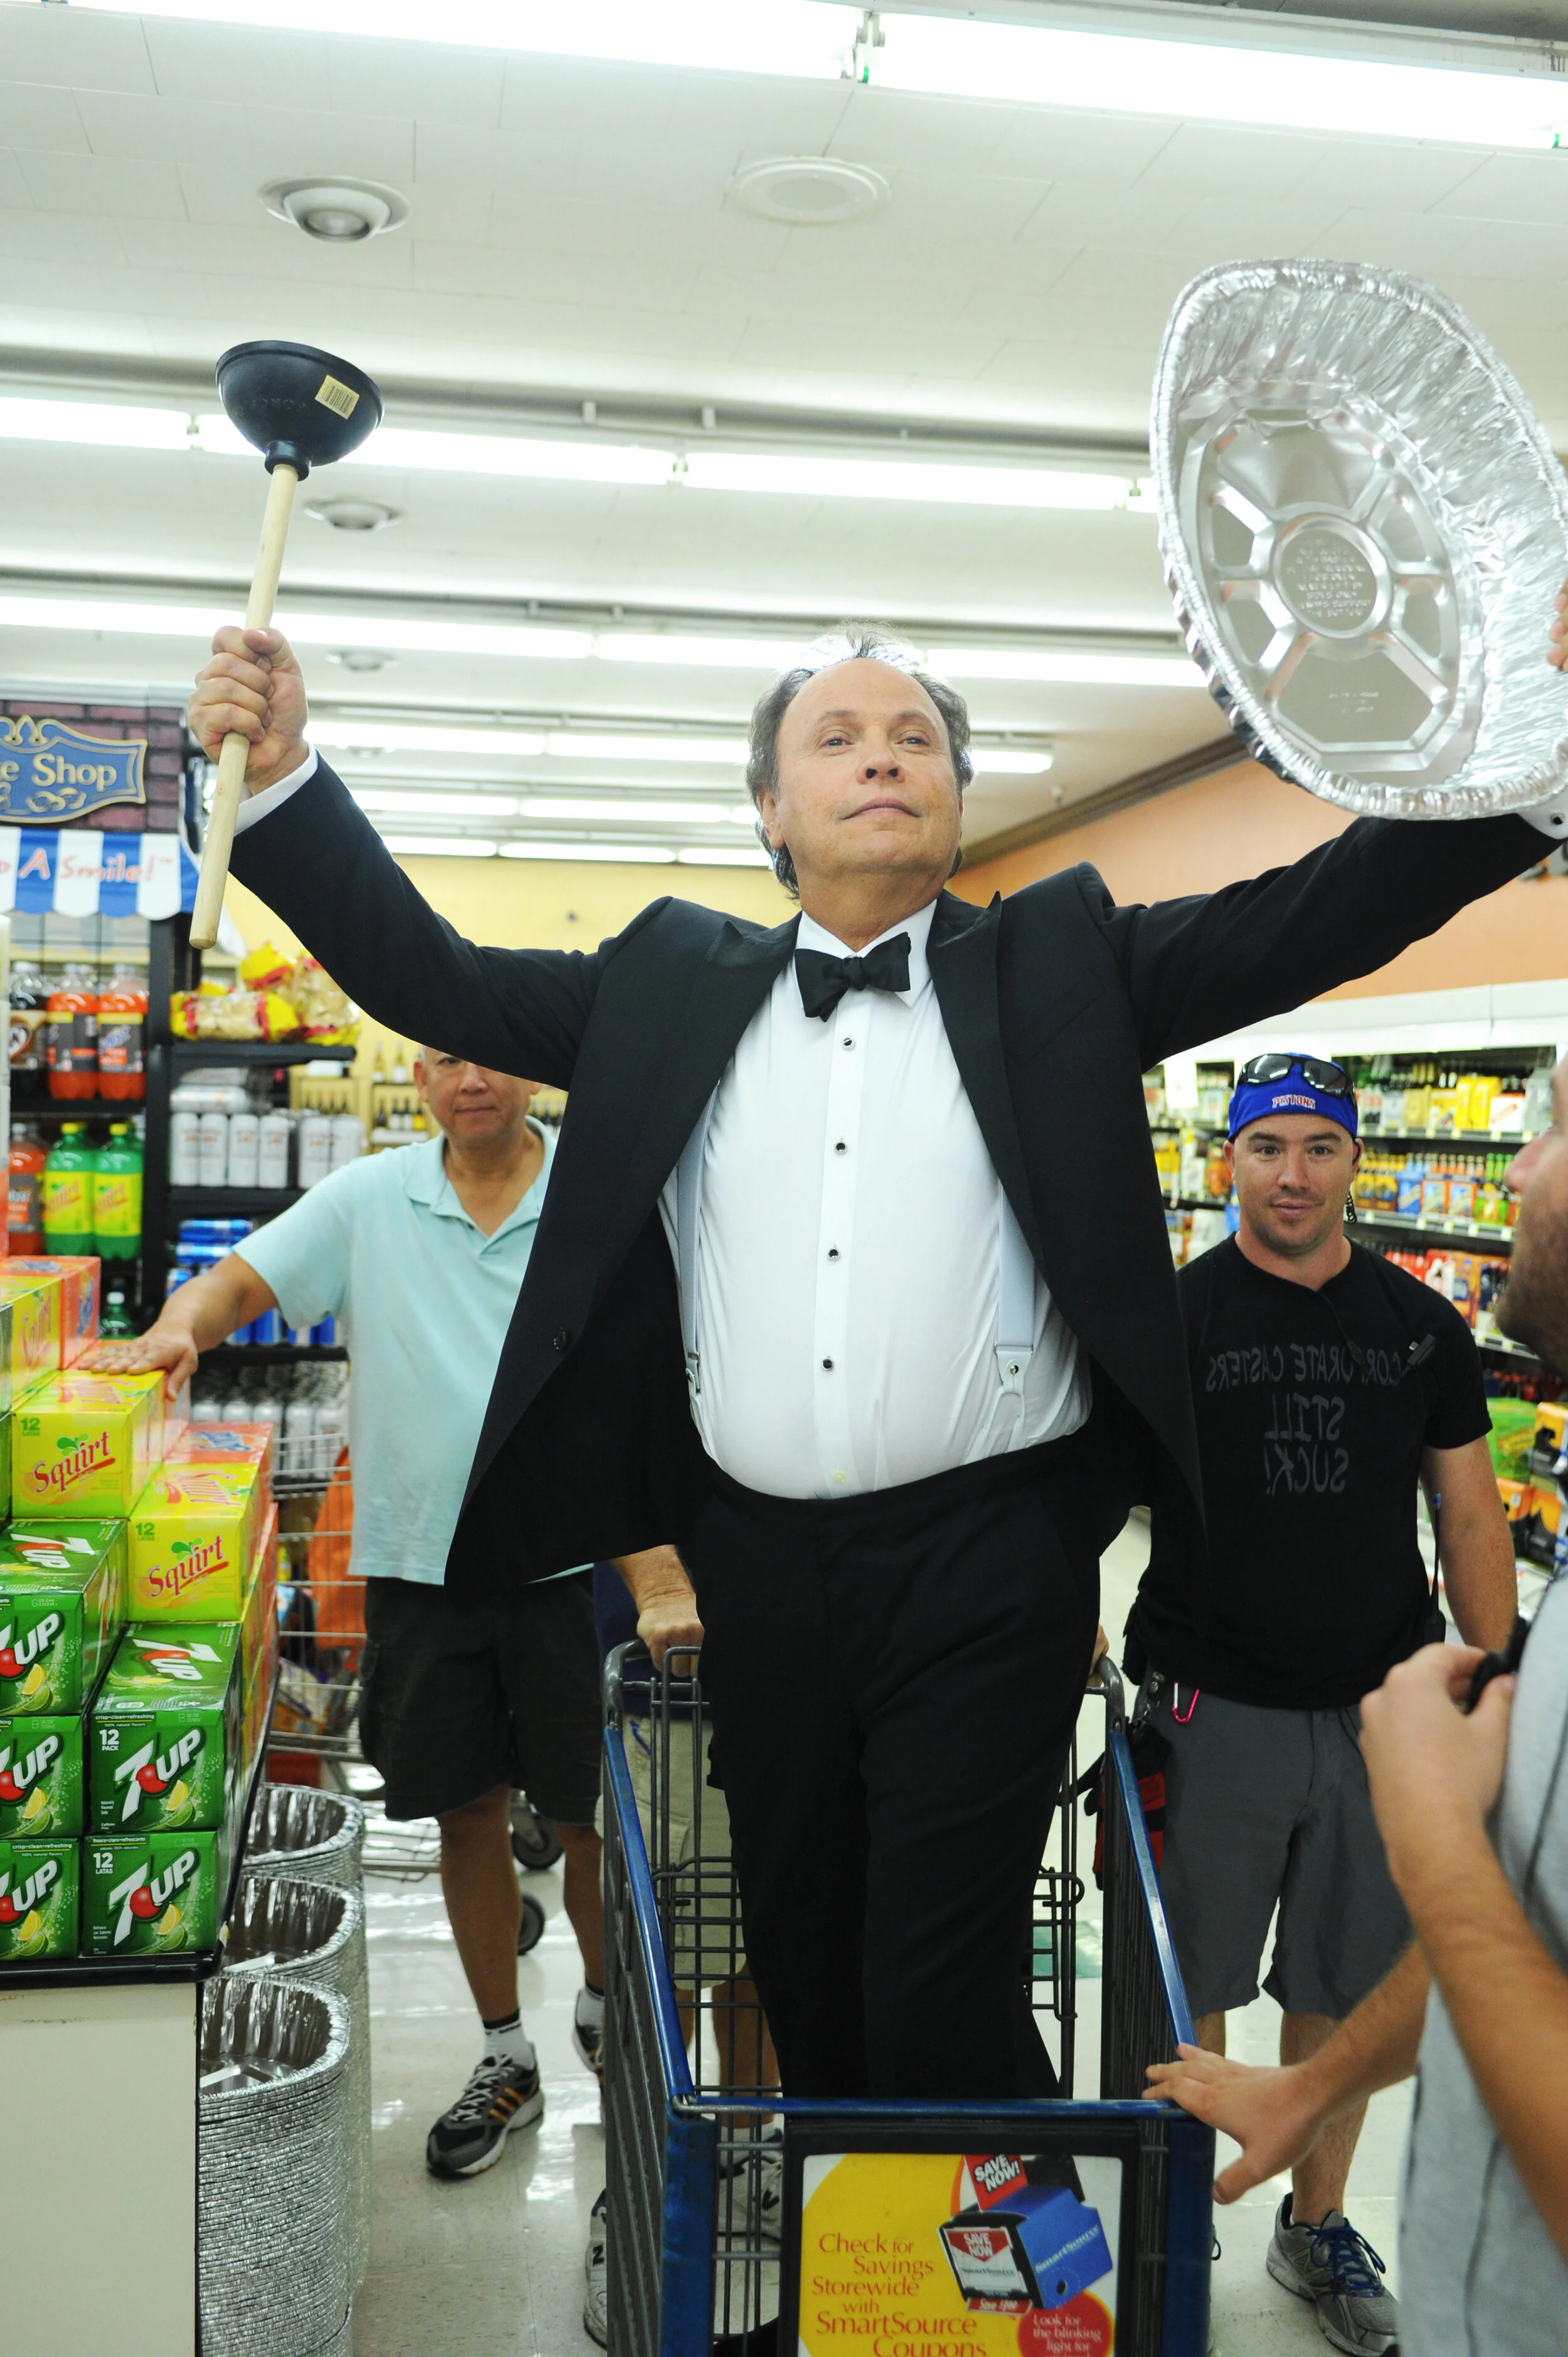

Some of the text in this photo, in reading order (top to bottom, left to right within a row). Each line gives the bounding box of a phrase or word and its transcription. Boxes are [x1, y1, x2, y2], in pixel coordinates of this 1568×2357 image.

[32, 753, 117, 792] Shop
[18, 847, 51, 880] A
[1272, 1094, 1315, 1110] PISTONS
[21, 1418, 40, 1430] 12
[33, 1430, 110, 1493] Squirt
[135, 1523, 155, 1536] 12
[148, 1534, 224, 1597] Squirt
[99, 1729, 119, 1745] 12
[115, 1728, 201, 1822] 7UP
[93, 1852, 113, 1868] 12
[109, 1851, 195, 1946] 7UP
[974, 2154, 1009, 2181] SAVE
[985, 2161, 1020, 2192] NOW!
[819, 2232, 914, 2254] Check for
[963, 2232, 991, 2245] SAVE
[970, 2245, 993, 2257] NOW
[854, 2255, 934, 2280] Savings
[812, 2275, 919, 2297] Storewide
[843, 2299, 880, 2314] with
[817, 2310, 977, 2335] SmartSource
[1034, 2314, 1081, 2326] Look for
[1033, 2326, 1102, 2342] the blinking
[872, 2334, 987, 2357] Coupons
[1046, 2339, 1091, 2353] light for
